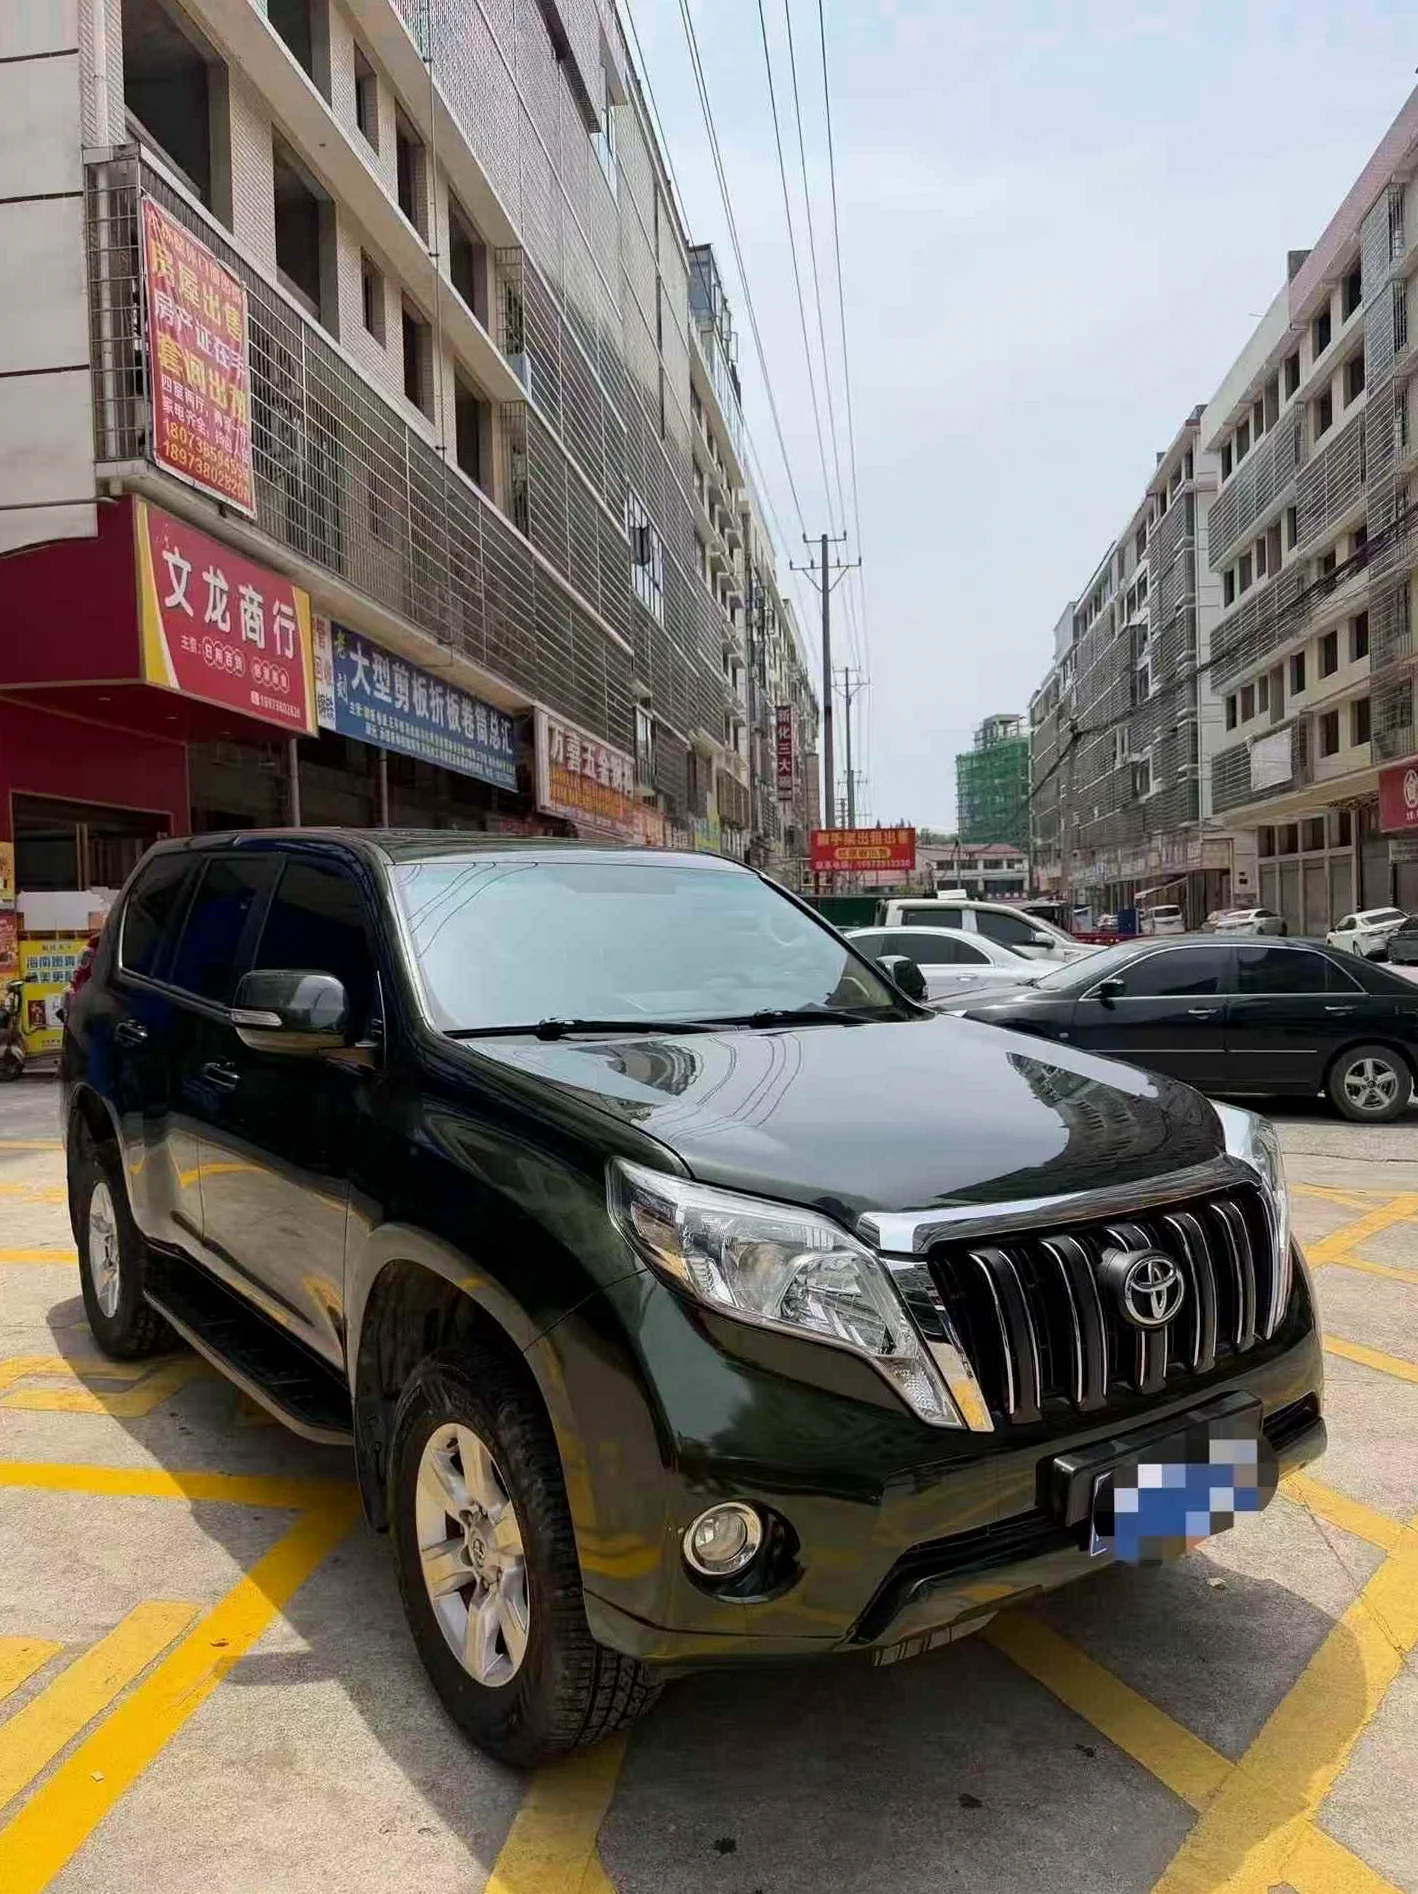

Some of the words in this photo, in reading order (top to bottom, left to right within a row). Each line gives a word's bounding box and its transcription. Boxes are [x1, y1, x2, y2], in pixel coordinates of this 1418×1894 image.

[154, 289, 245, 380] 房产证在手
[162, 546, 296, 659] 文龙商行
[349, 641, 513, 755] 大型剪板折板卷筒总汇
